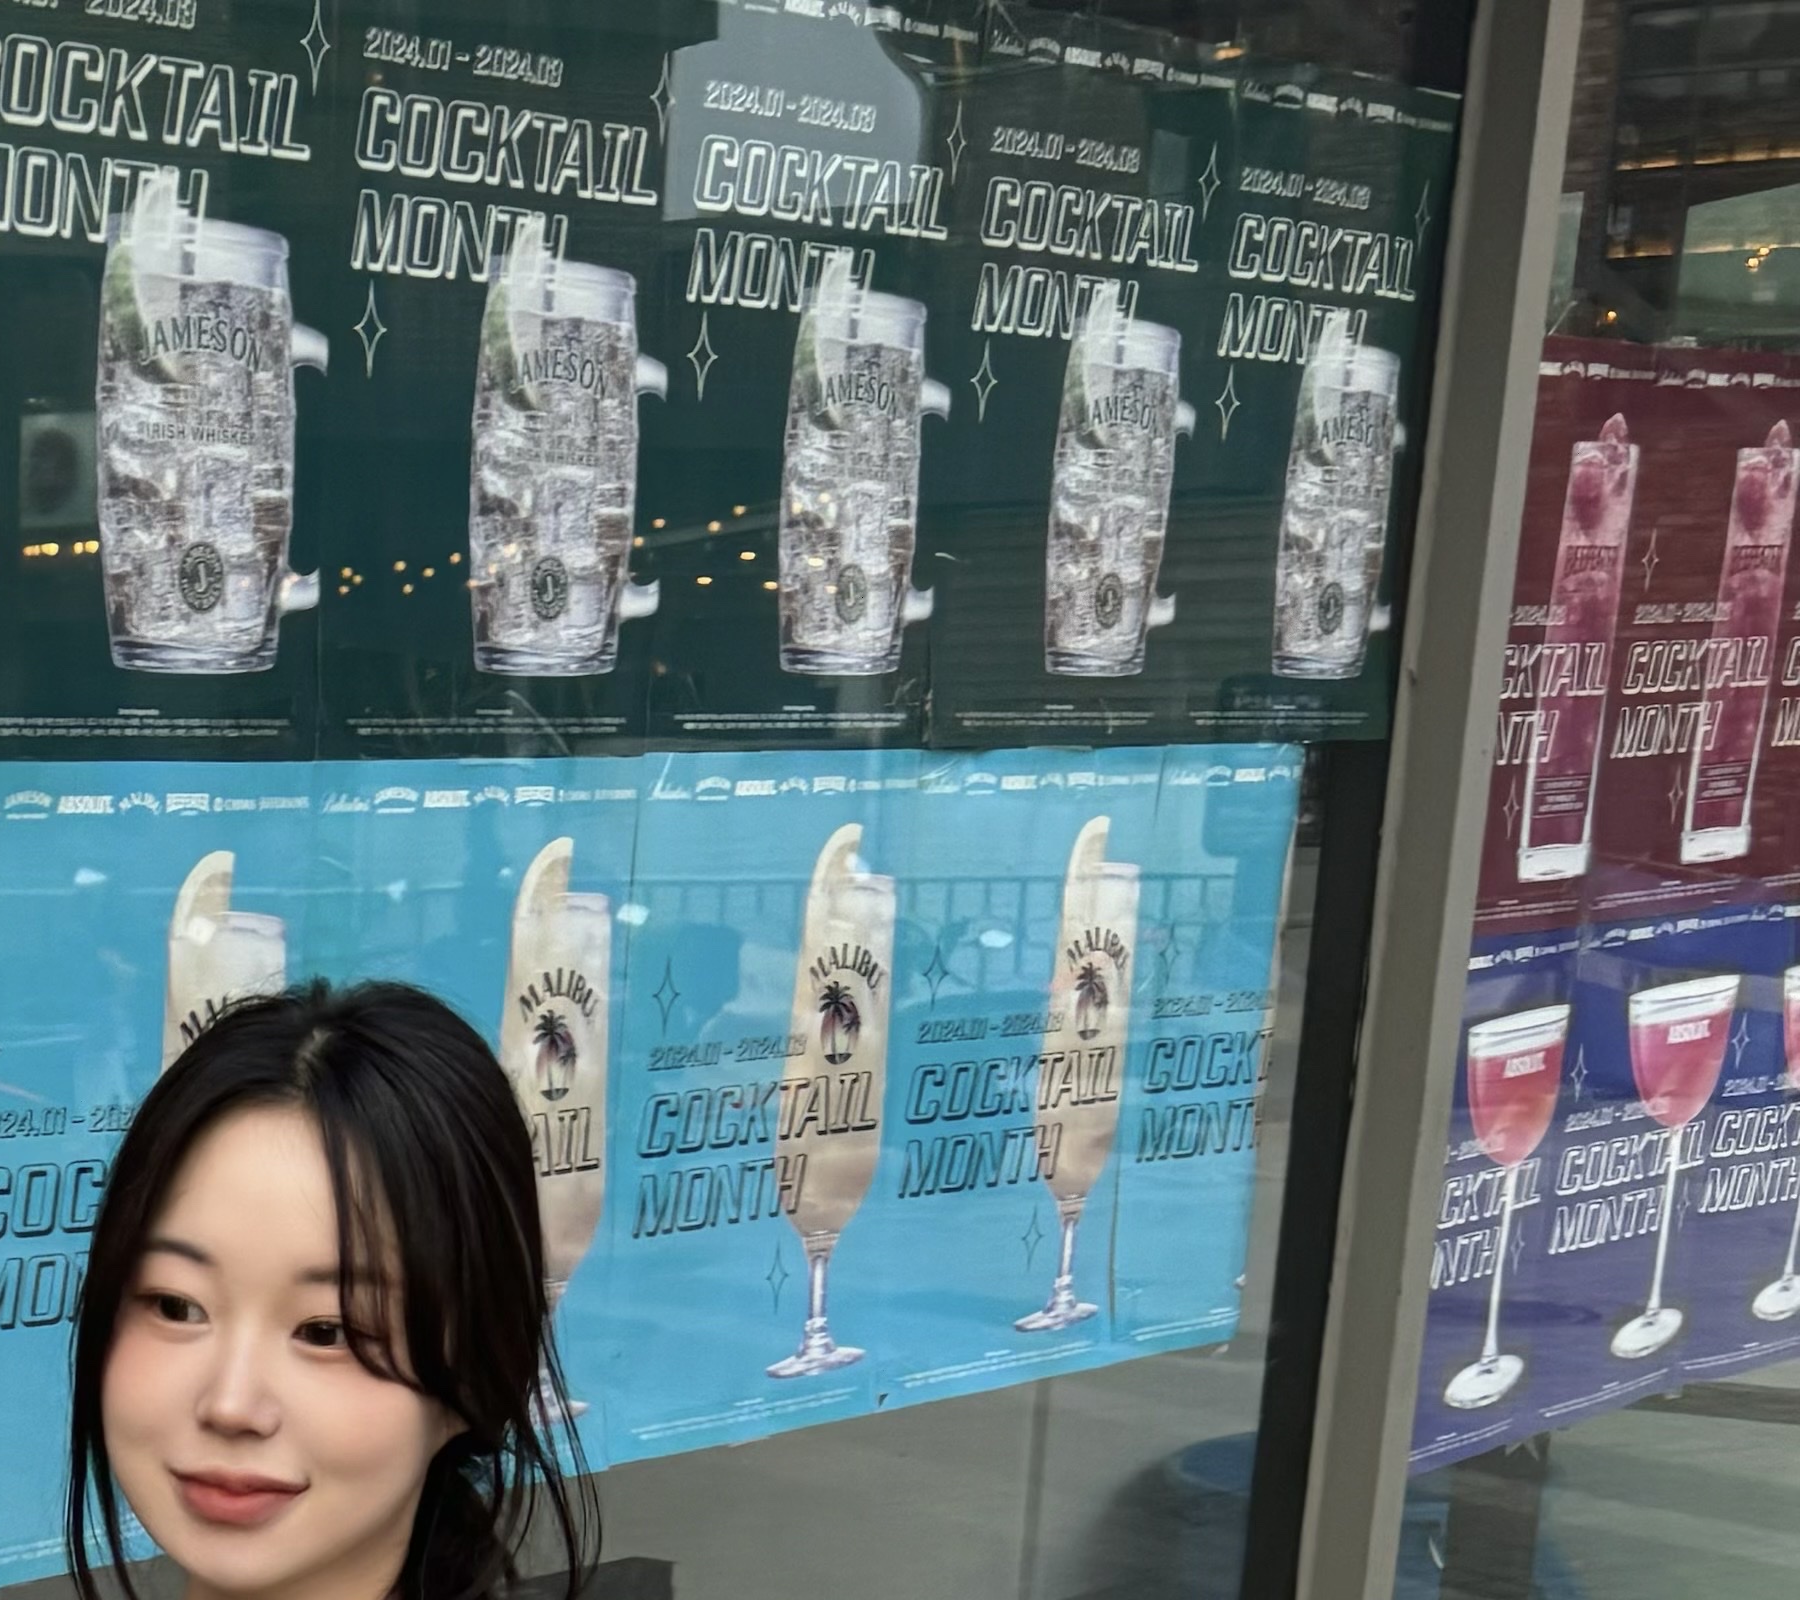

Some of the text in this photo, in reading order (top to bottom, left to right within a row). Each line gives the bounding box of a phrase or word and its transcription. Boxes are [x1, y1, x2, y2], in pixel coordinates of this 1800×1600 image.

[363, 26, 451, 71] 2024.01
[472, 45, 562, 88] 2024.03
[705, 80, 782, 116] 2024.01
[355, 87, 657, 207] COCKTAIL
[991, 126, 1062, 162] 2024.01
[694, 134, 948, 241] COCKTAIL
[981, 176, 1199, 274] COCKTAIL
[1230, 213, 1416, 302] COCKTAIL
[1622, 636, 1770, 695] COCKTAIL
[1610, 700, 1723, 759] MONTH
[635, 1070, 879, 1161] COCKTAIL
[904, 1044, 1119, 1126] COCKTAIL
[632, 1152, 807, 1240] MONTH
[898, 1123, 1062, 1201] MONTH
[1548, 1185, 1667, 1255] MONTH
